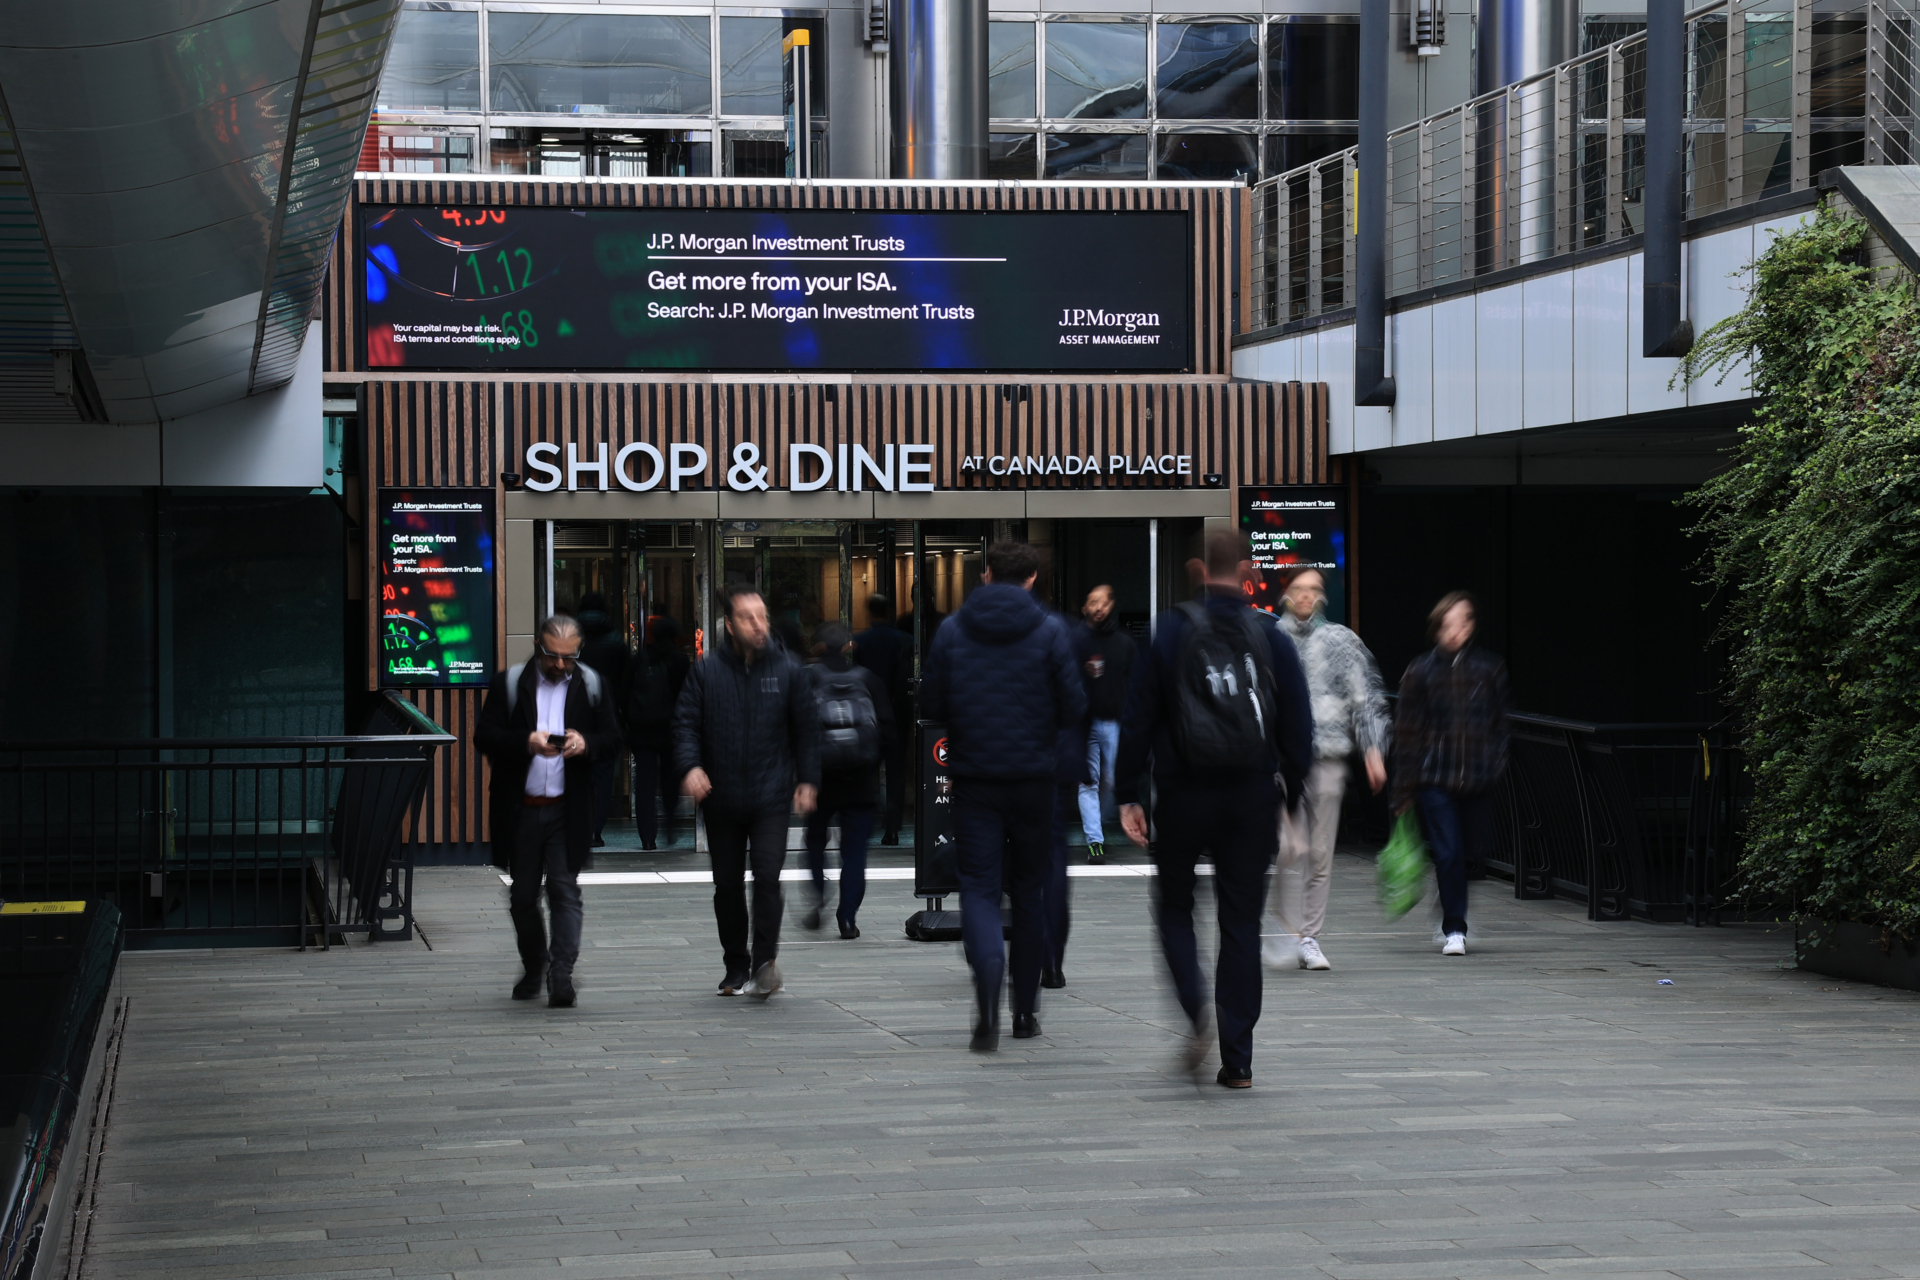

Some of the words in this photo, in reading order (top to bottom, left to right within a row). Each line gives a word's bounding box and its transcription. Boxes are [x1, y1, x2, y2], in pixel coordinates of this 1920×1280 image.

[646, 233, 675, 250] J.P.
[679, 233, 748, 254] Morgan
[752, 234, 849, 251] Investment
[851, 234, 906, 252] Trusts
[466, 248, 533, 295] 1.12
[647, 270, 687, 291] Get
[692, 275, 747, 291] more
[750, 271, 801, 291] from
[804, 276, 853, 296] your
[857, 271, 897, 292] ISA.
[647, 301, 715, 319] Search:
[718, 302, 747, 319] J.P.
[751, 302, 819, 323] Morgan
[823, 303, 919, 320] Investment
[921, 303, 975, 320] Trusts
[392, 323, 413, 332] Your
[412, 323, 442, 334] capital
[442, 325, 461, 335] may
[461, 324, 474, 333] be
[473, 324, 483, 333] at
[484, 324, 502, 333] risk.
[393, 334, 408, 343] ISA
[407, 334, 433, 343] terms
[433, 334, 451, 343] and
[451, 334, 496, 344] conditions
[495, 335, 521, 346] apply.
[1059, 334, 1090, 345] ASSET
[1092, 334, 1161, 345] MANAGEMENT
[524, 440, 709, 494] SHOP
[726, 440, 771, 494] &
[789, 443, 935, 492] DINE
[961, 455, 985, 472] AT
[987, 454, 1102, 477] CANADA
[1108, 453, 1193, 476] PLACE
[392, 502, 403, 510] J.P.
[403, 502, 429, 510] Morgan
[428, 502, 463, 510] Investment
[462, 502, 483, 510] Trusts
[1250, 500, 1262, 508] J.P.
[1261, 500, 1285, 509] Morgan
[1284, 500, 1318, 508] Investment
[392, 533, 410, 543] Get
[410, 535, 435, 543] more
[434, 533, 457, 543] from
[1250, 531, 1267, 540] Get
[1267, 532, 1291, 540] more
[1290, 530, 1312, 540] from
[392, 546, 414, 556] your
[414, 544, 433, 554] ISA.
[1251, 543, 1272, 553] your
[1271, 541, 1289, 551] ISA.
[392, 557, 417, 565] Search:
[1261, 562, 1286, 571] Morgan
[1317, 561, 1336, 569] Trusts
[392, 565, 404, 573] J.P.
[403, 566, 429, 575] Morgan
[463, 565, 483, 573] Trusts
